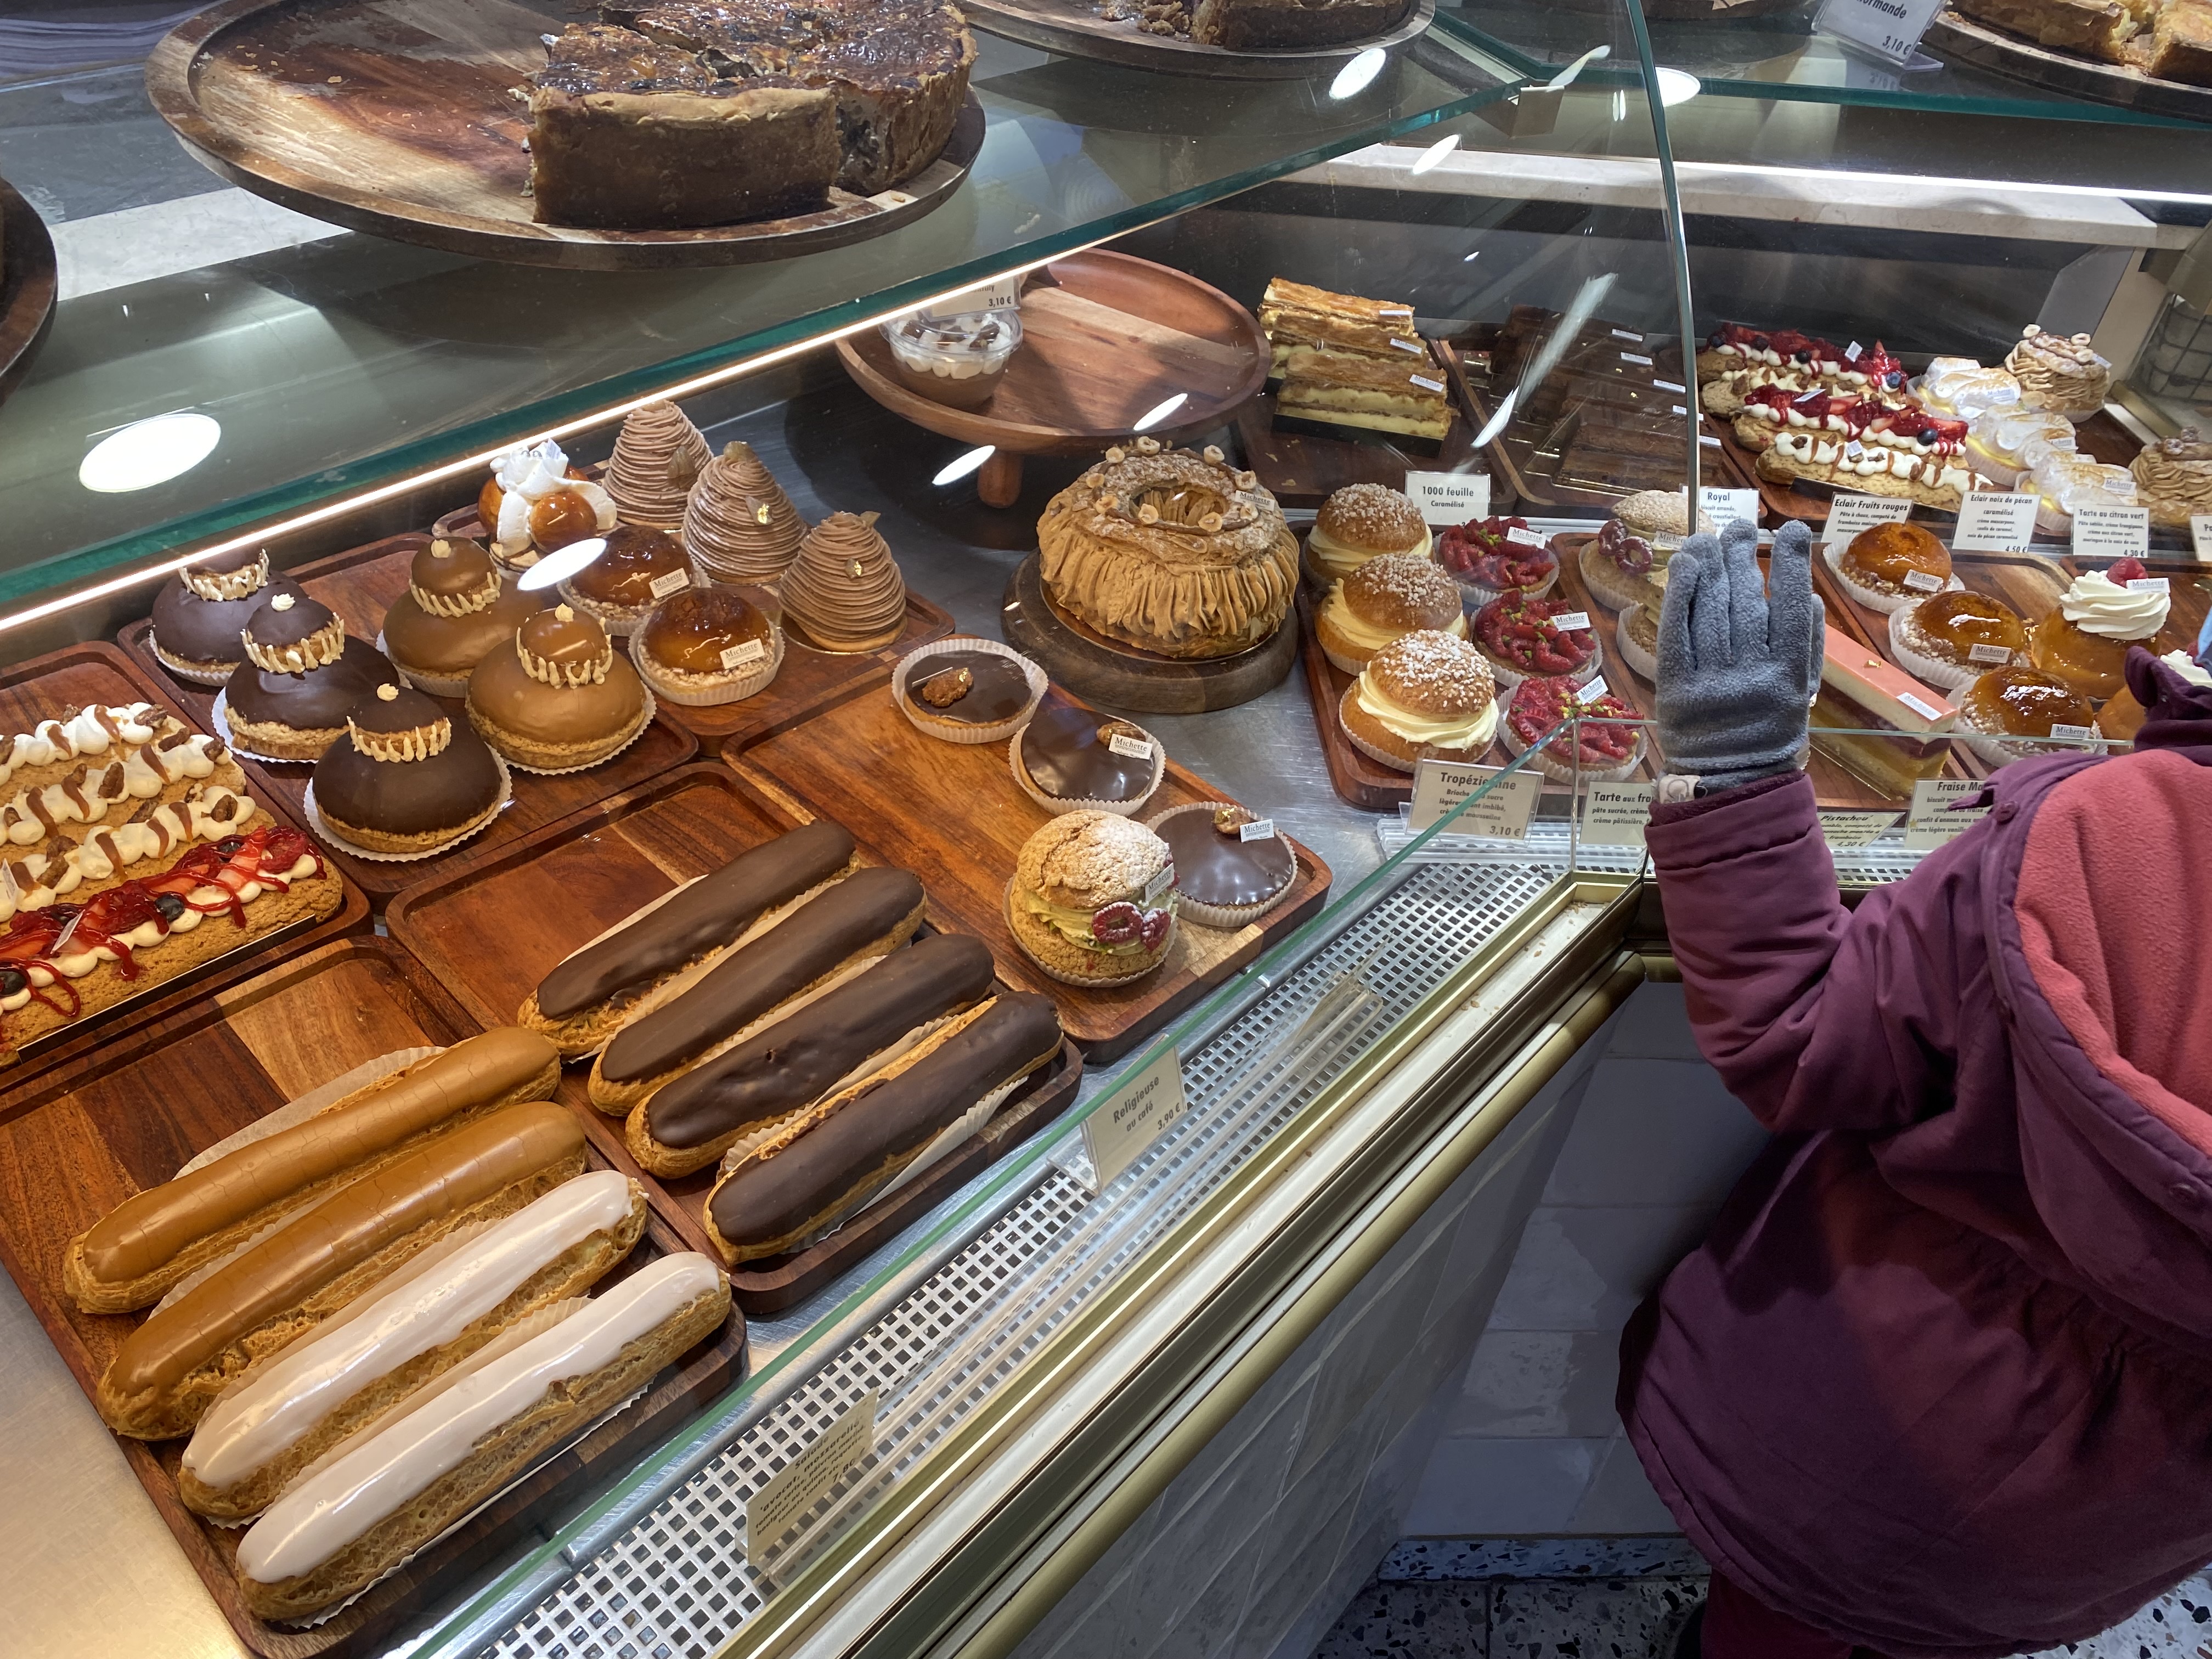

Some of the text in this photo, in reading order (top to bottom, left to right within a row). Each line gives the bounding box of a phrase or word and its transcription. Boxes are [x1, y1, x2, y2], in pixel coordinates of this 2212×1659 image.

[1882, 35, 1912, 55] 3,10 €
[989, 296, 1011, 307] 3,10 €
[1423, 486, 1474, 496] 1000 feuille
[1240, 492, 1271, 504] Michette
[1707, 492, 1730, 503] Royal
[1835, 499, 1908, 512] Eclair Fruits rouges
[1513, 528, 1543, 541] Michette
[654, 572, 682, 588] Michette
[1910, 572, 1938, 584] Michette
[1556, 614, 1585, 623] Michette
[725, 643, 758, 659] Michette
[1976, 646, 2007, 655] Michette
[1580, 679, 1602, 697] Michette
[2056, 726, 2086, 735] Michette
[1115, 737, 1147, 752] Michette
[1937, 782, 1966, 791] Fraise
[1447, 789, 1470, 797] Brioche
[1594, 792, 1621, 802] Tarte
[1482, 803, 1506, 812] imbibé,
[1466, 812, 1501, 821] mousseline
[1244, 823, 1270, 833] Michette
[1489, 826, 1520, 837] 3,10 €
[1148, 869, 1171, 892] Michette
[1114, 1076, 1159, 1124] Religieuse
[1126, 1101, 1153, 1132] au café
[1158, 1102, 1181, 1130] 3,90 €
[795, 1436, 829, 1470] Salade
[757, 1501, 789, 1536] boulgour
[791, 1492, 800, 1502] ou
